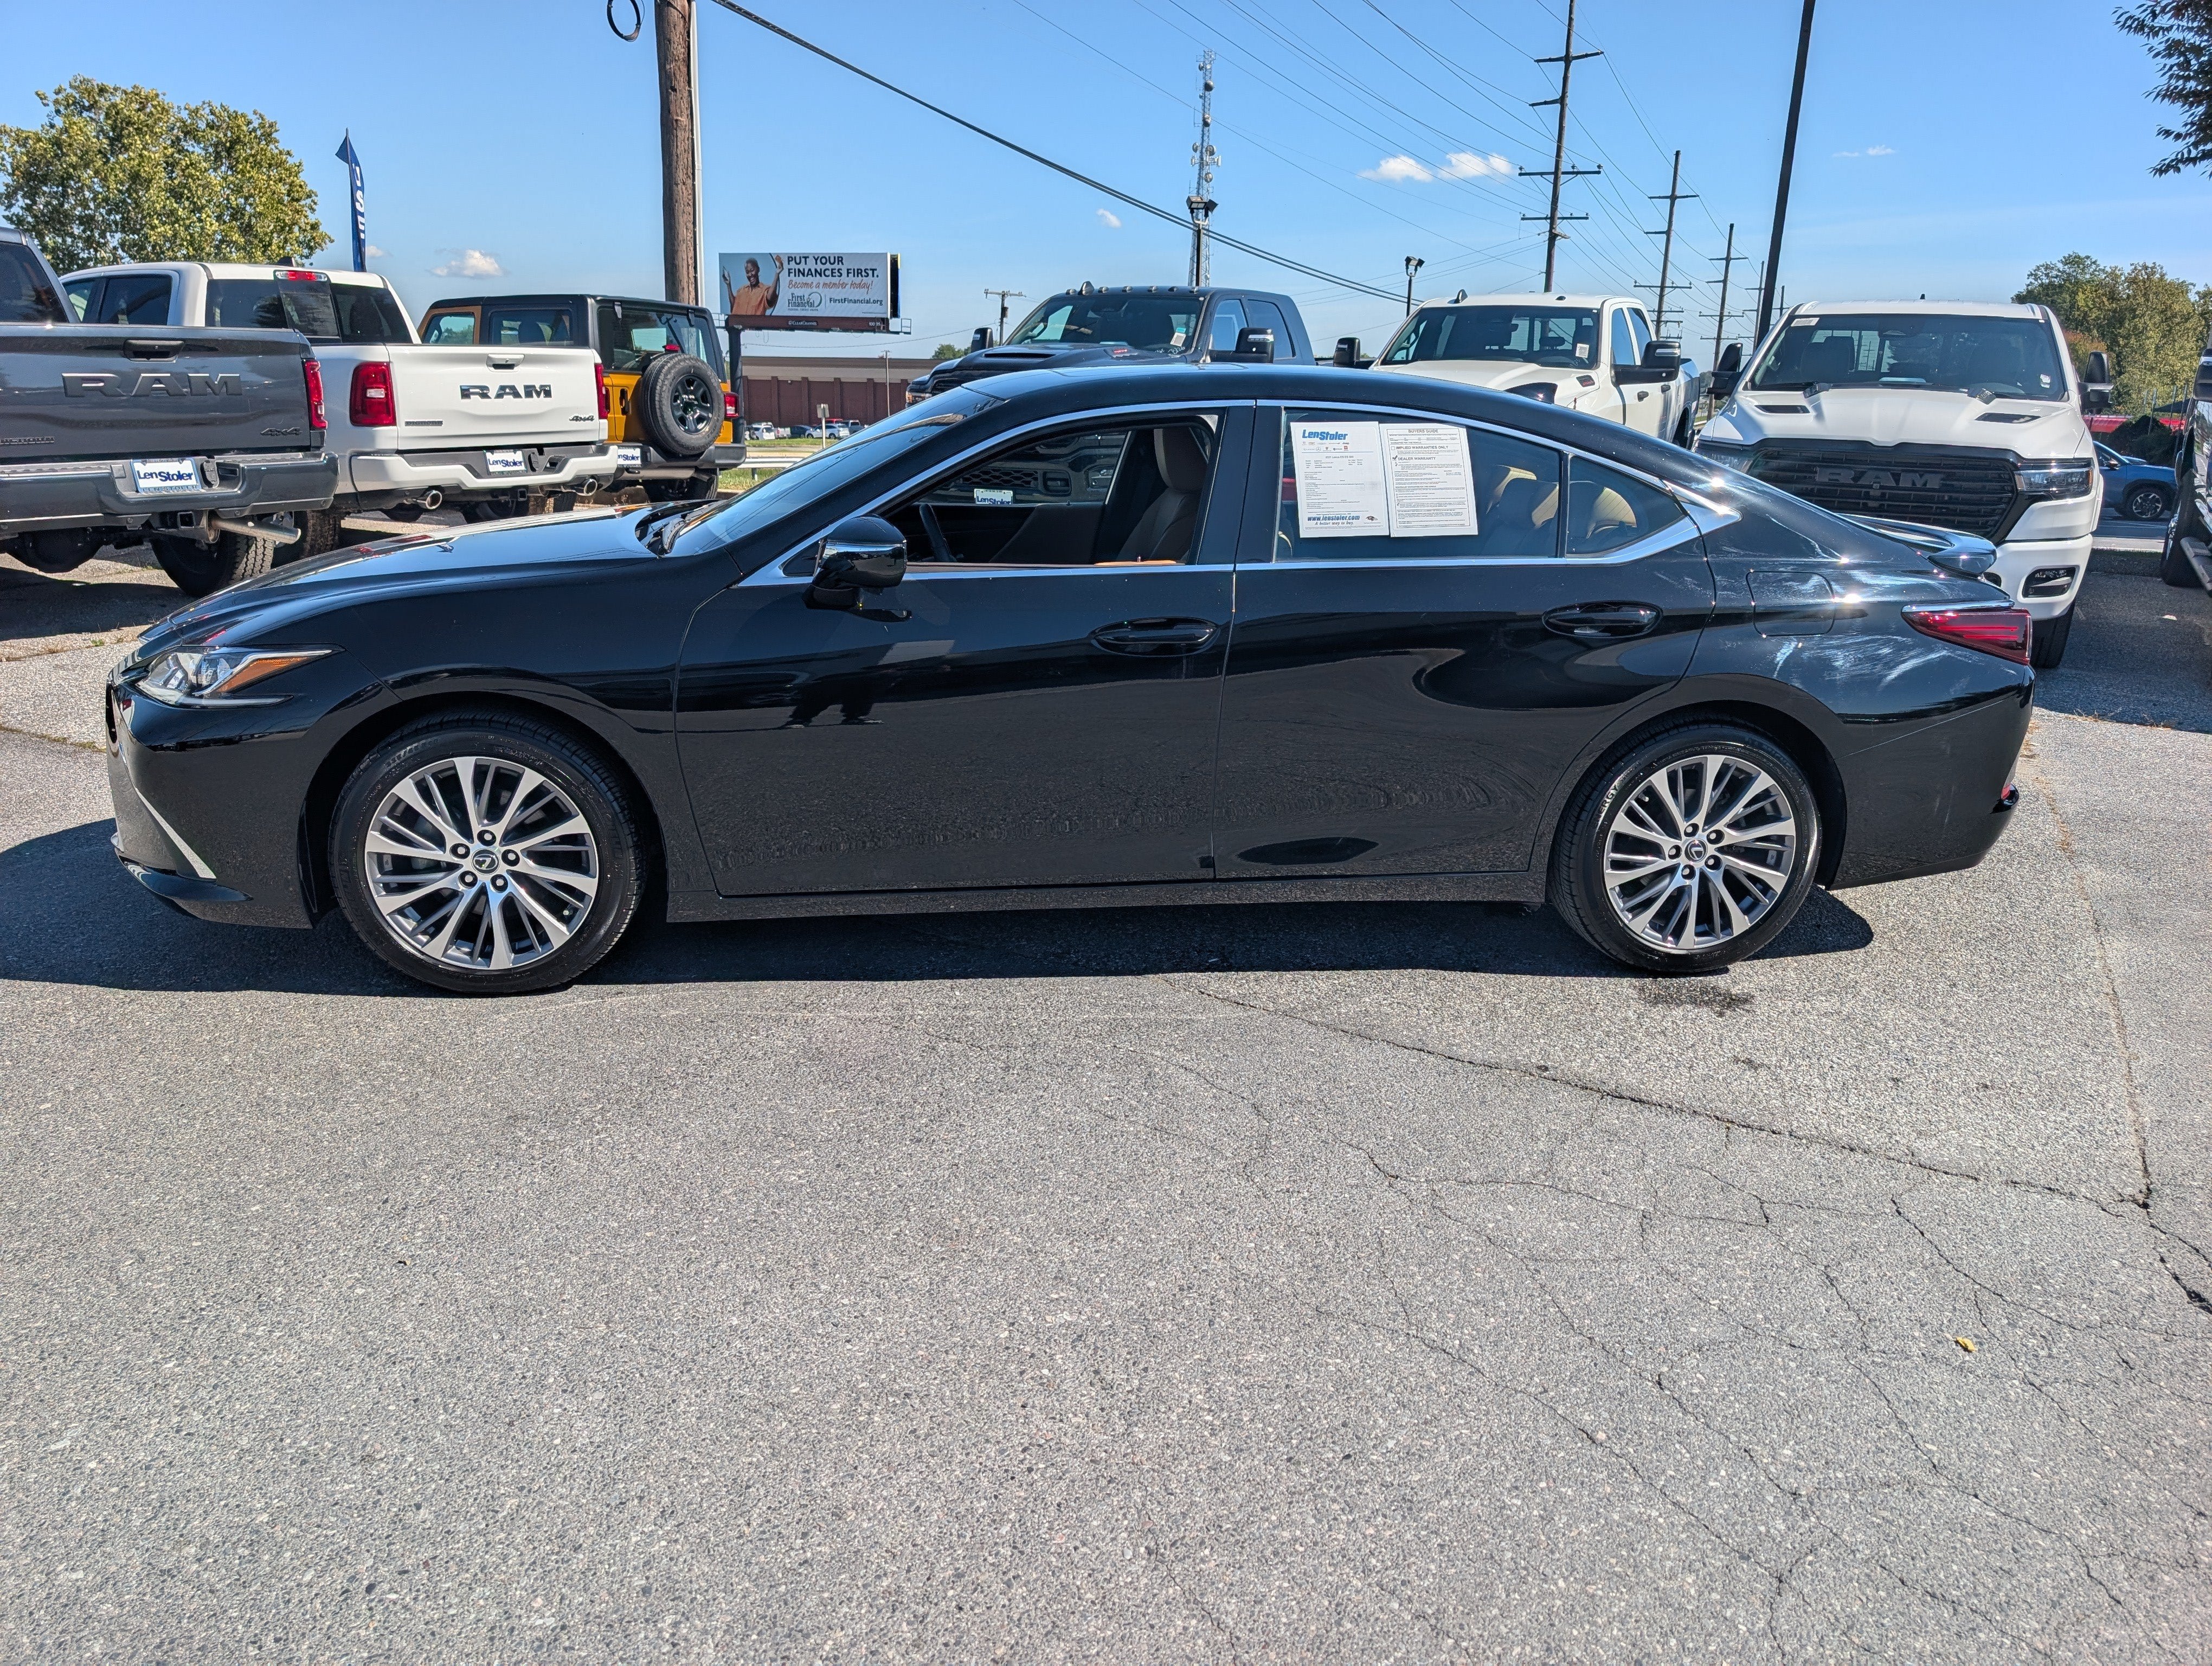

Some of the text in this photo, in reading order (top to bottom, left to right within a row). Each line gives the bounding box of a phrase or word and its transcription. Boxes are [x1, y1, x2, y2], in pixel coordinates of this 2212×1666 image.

[788, 256, 844, 265] PUT YOUR
[788, 268, 879, 278] FINANCES FIRST.
[788, 279, 814, 289] Become
[822, 279, 848, 289] member
[850, 279, 873, 294] today!
[791, 293, 805, 301] First
[829, 298, 883, 306] FirstFinancial.org
[788, 299, 815, 307] Financial
[62, 373, 242, 397] RAM
[460, 385, 552, 399] RAM
[1816, 467, 1943, 489] RAM
